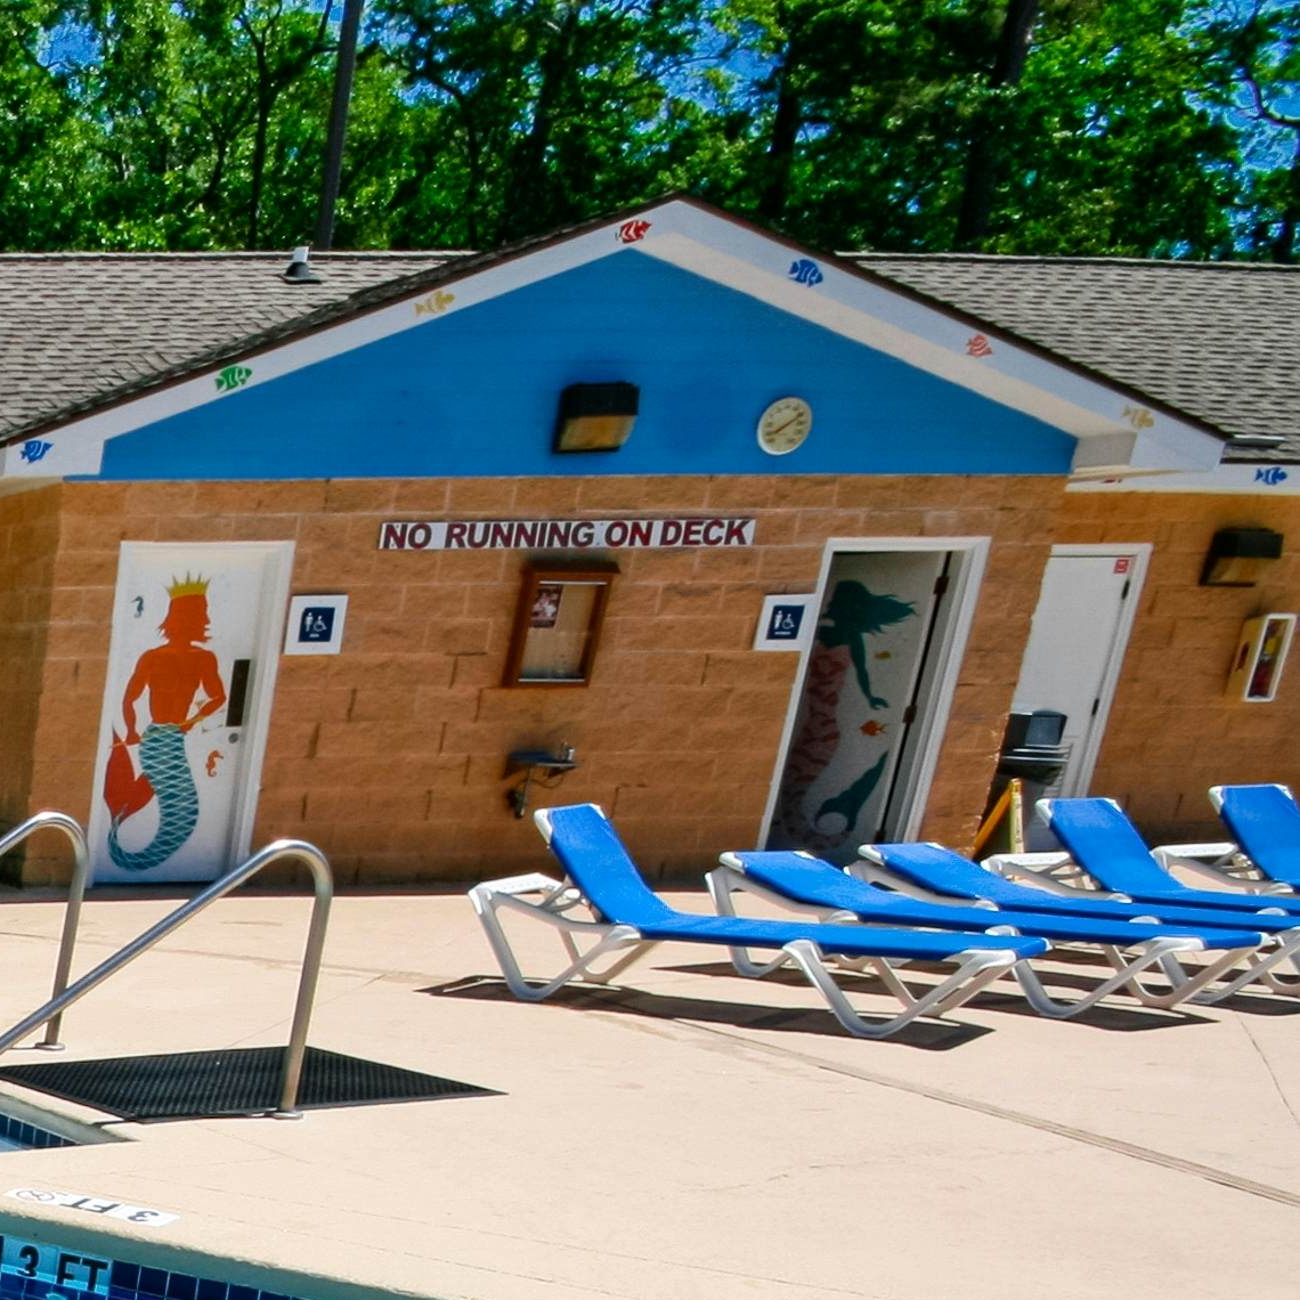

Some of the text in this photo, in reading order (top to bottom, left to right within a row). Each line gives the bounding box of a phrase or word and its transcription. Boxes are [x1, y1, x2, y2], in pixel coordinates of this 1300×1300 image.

[383, 518, 751, 549] NO RUNNING ON DECK
[60, 1198, 159, 1222] 3 FT
[17, 1245, 109, 1292] 3 FT
